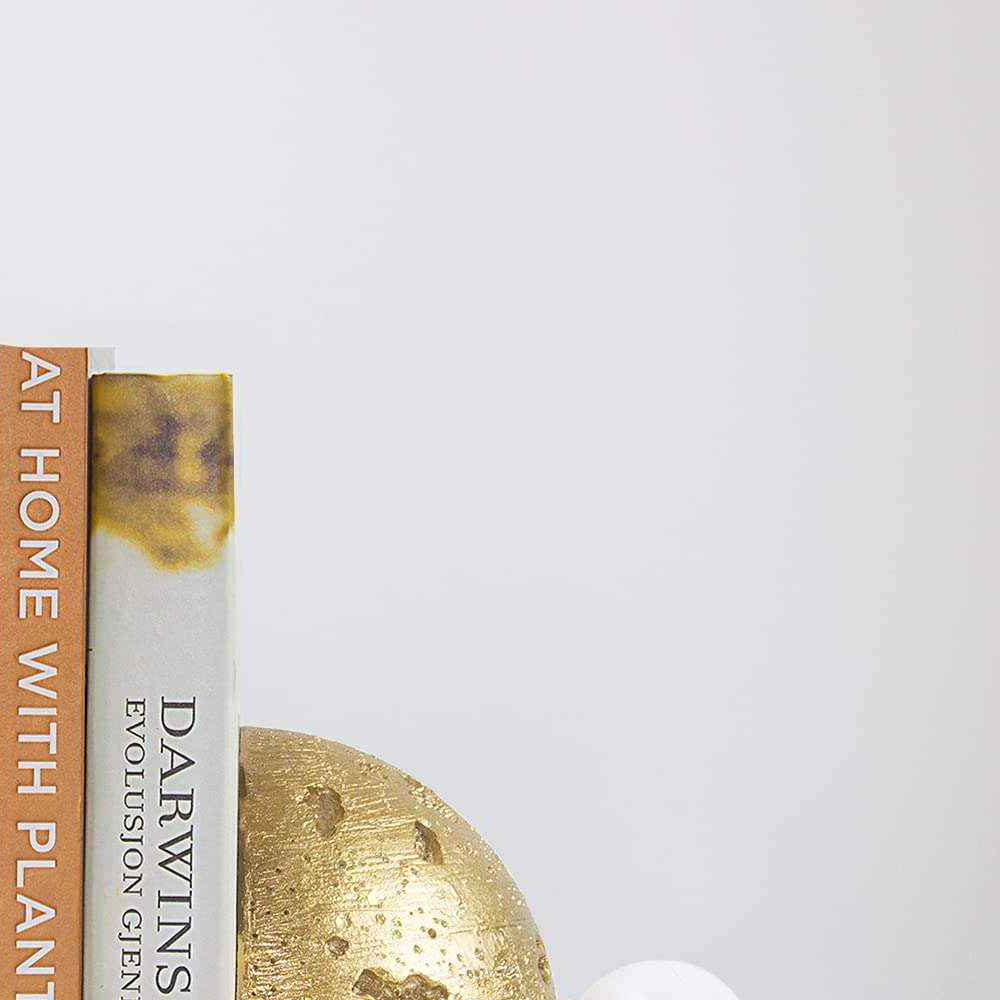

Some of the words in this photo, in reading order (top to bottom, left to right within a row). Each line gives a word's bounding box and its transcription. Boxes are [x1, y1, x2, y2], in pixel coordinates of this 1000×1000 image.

[19, 350, 61, 424] AT
[18, 449, 61, 619] HOME
[17, 643, 59, 794] WITH
[119, 698, 147, 896] EVOLUSJON
[155, 696, 197, 995] DARWINS
